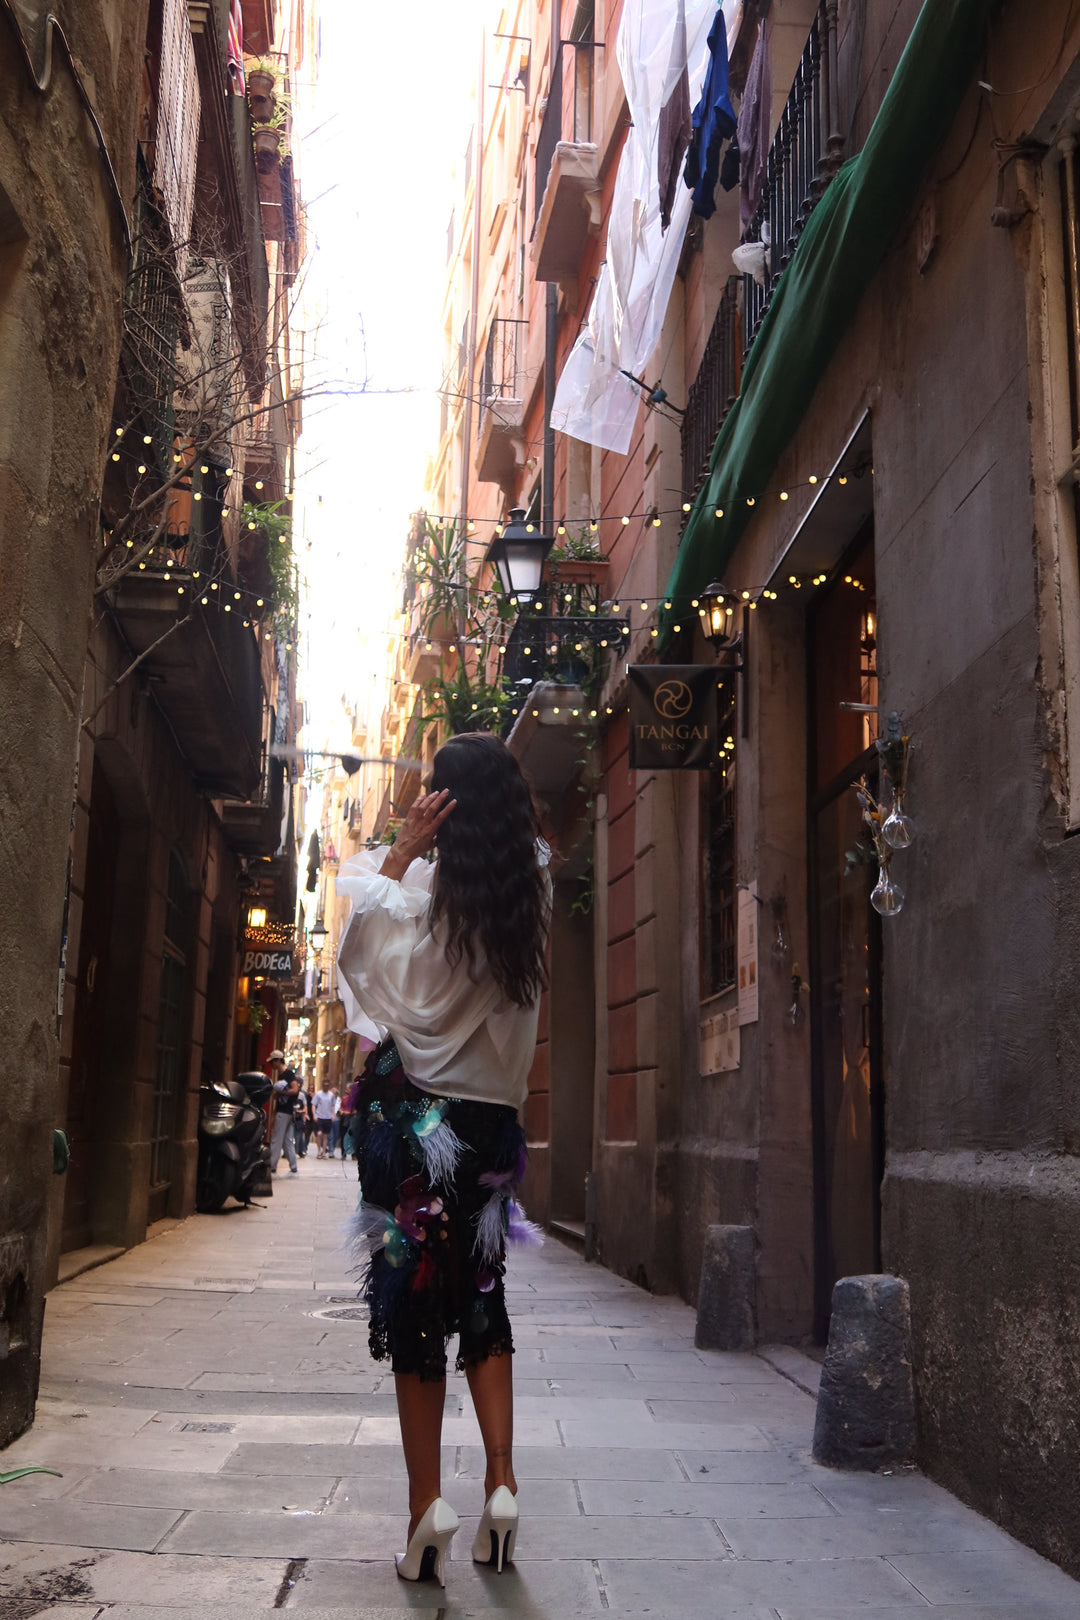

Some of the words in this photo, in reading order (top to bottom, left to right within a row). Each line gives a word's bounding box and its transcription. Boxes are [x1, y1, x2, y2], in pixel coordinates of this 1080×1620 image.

[635, 724, 709, 740] TANGAI
[661, 743, 686, 751] BCN
[243, 951, 292, 973] BODEGA
